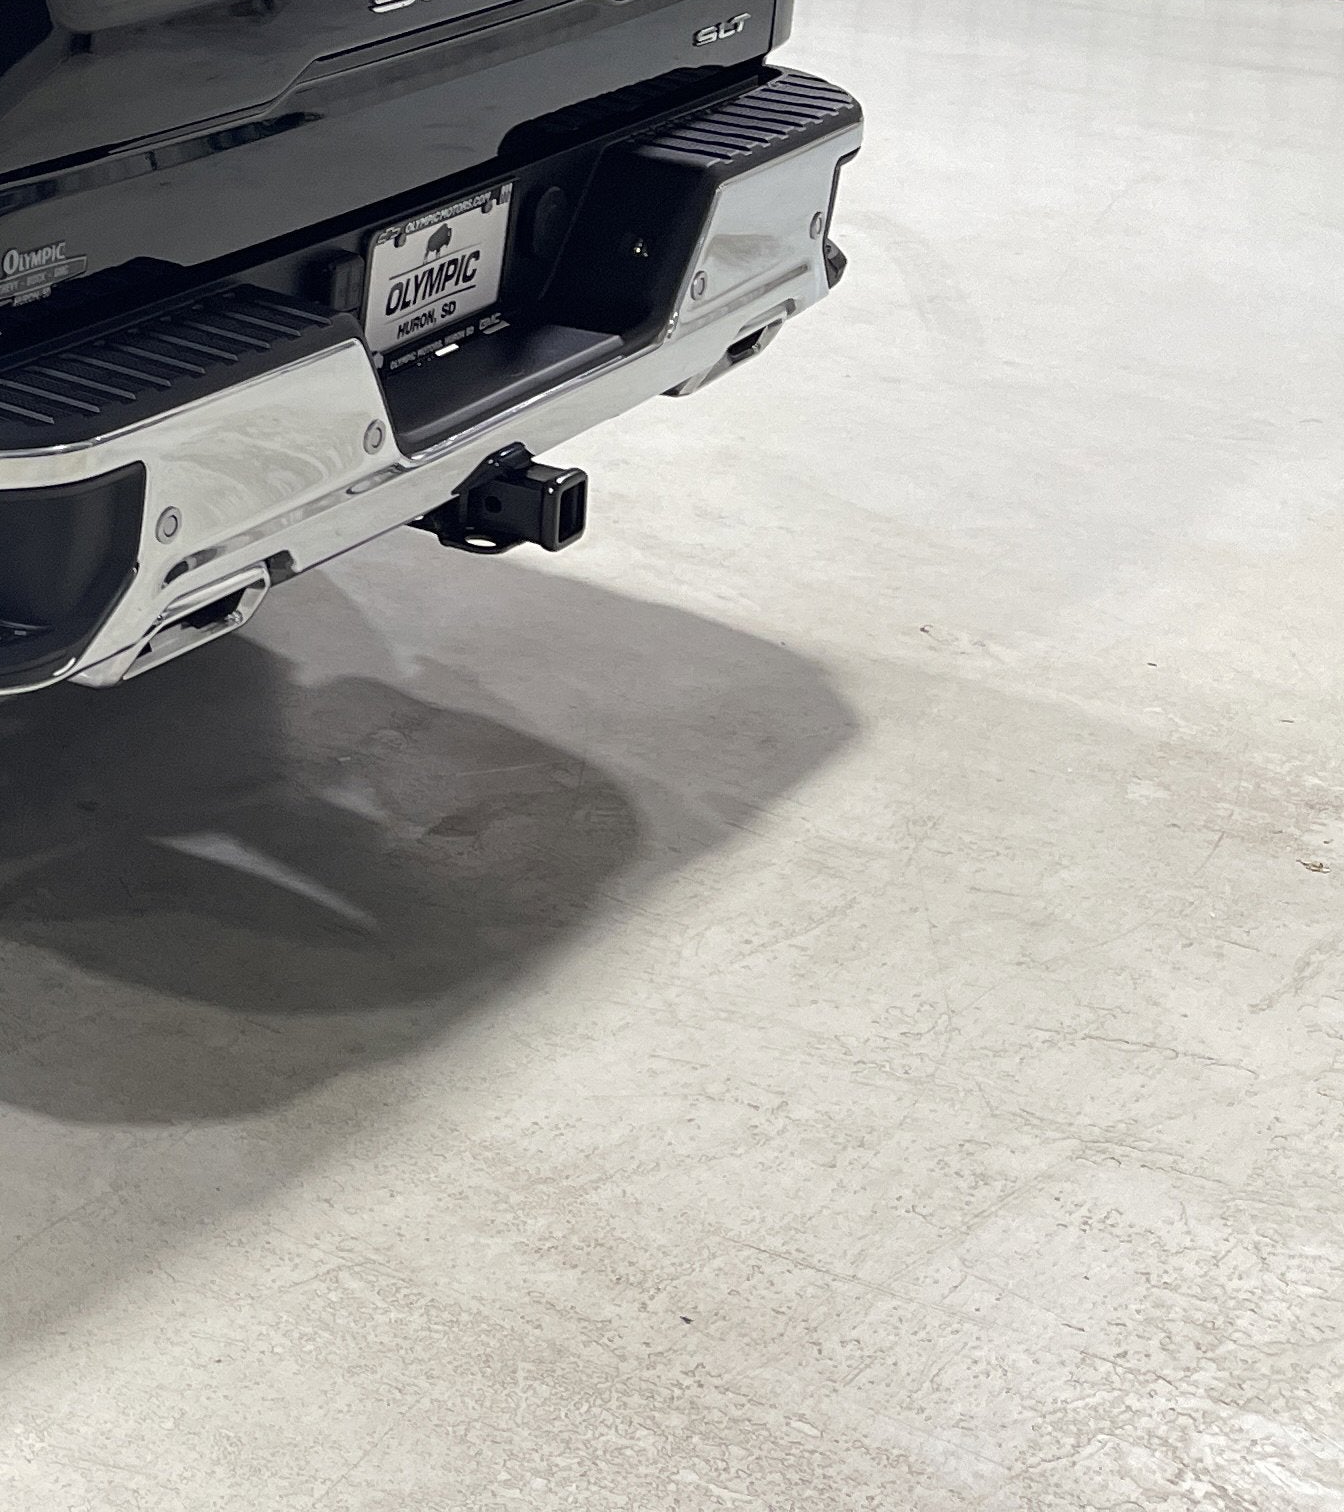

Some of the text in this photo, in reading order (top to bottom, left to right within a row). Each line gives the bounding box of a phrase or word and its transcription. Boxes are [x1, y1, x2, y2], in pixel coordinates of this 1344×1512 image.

[693, 12, 752, 46] SLT
[385, 250, 481, 316] OLYMPIC
[397, 300, 457, 340] HURON, SD
